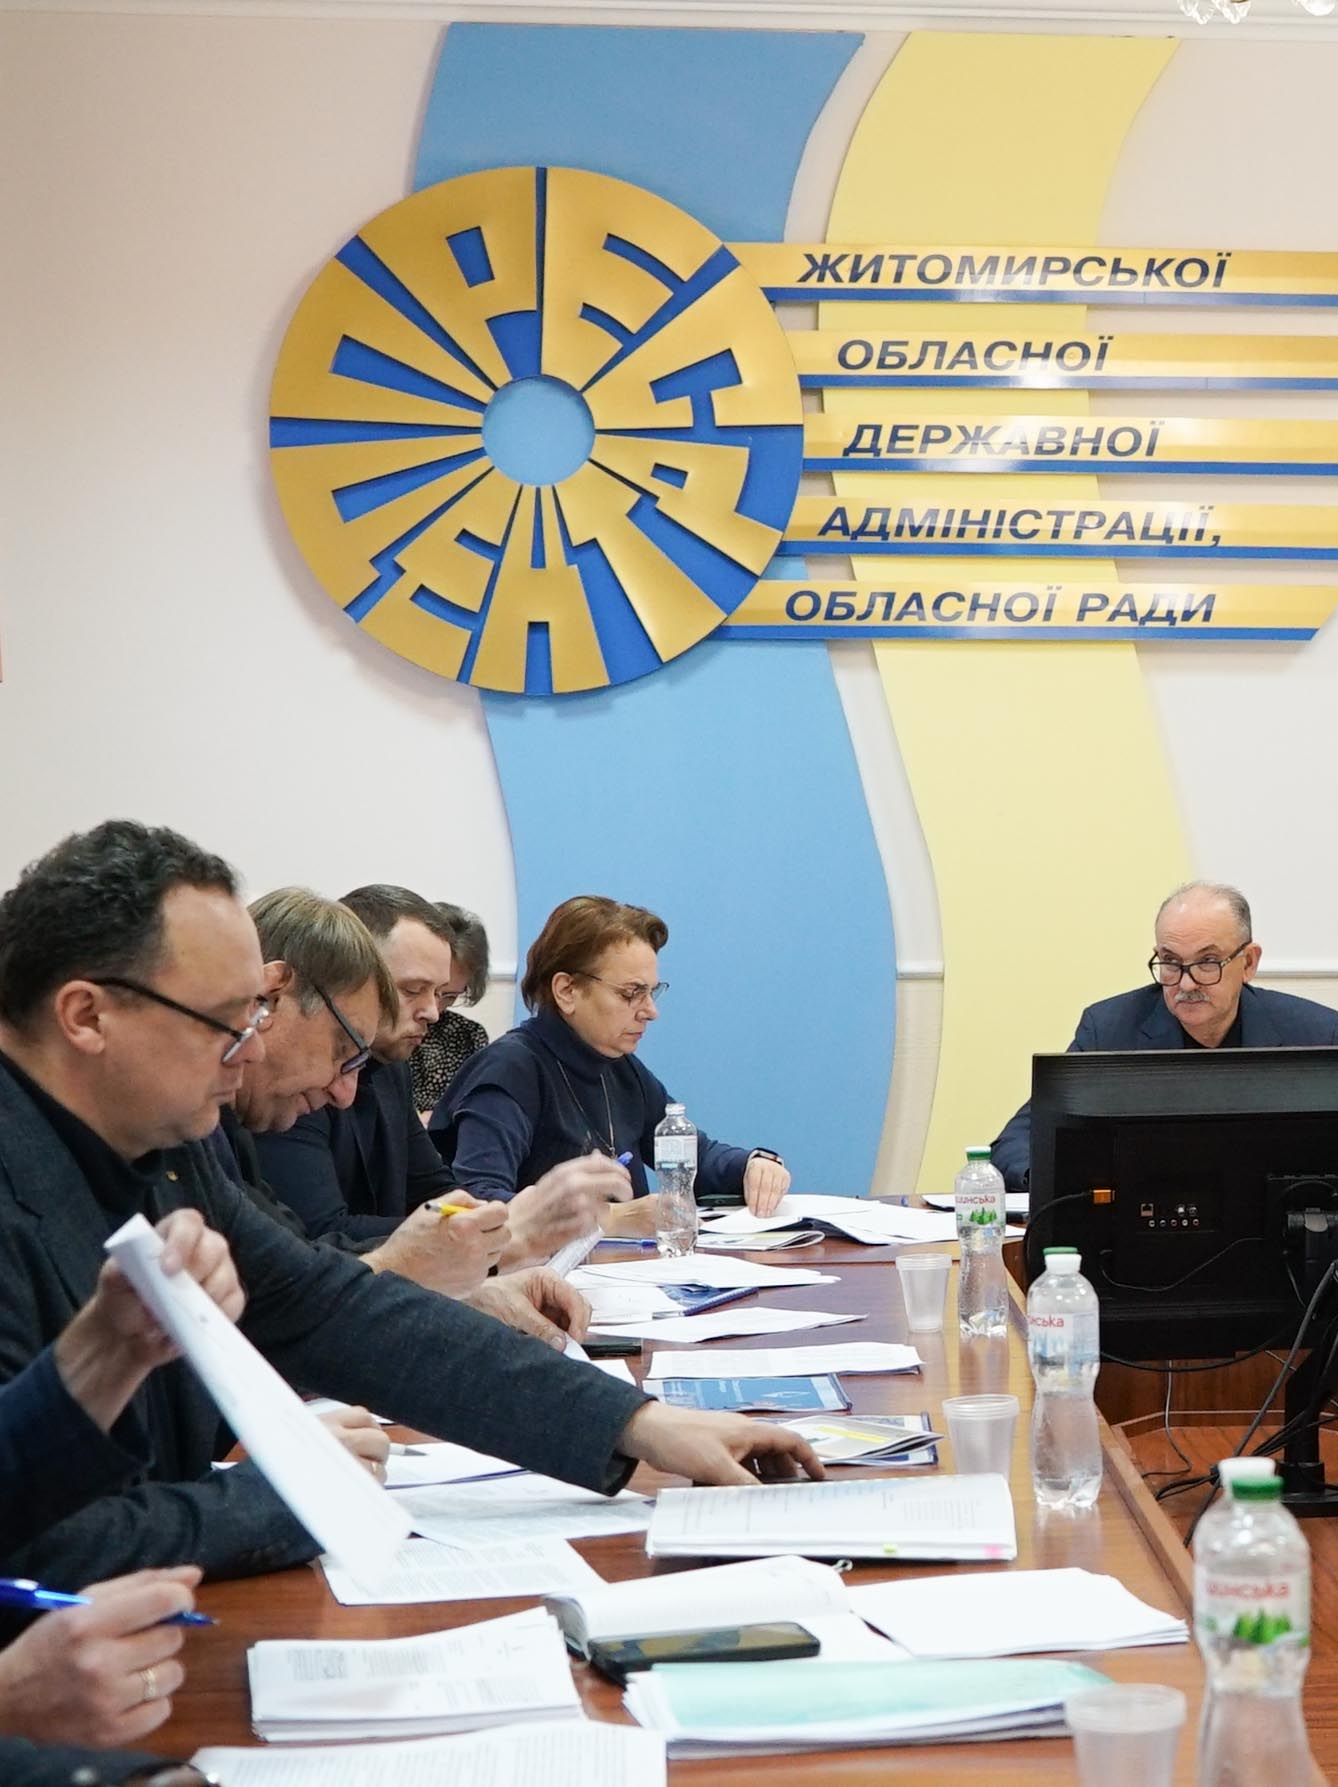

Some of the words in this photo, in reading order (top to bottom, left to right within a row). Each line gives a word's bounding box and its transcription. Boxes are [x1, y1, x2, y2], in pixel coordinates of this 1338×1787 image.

[797, 251, 1233, 288] ЖИТОМИРСЬКОЇ
[837, 335, 1114, 371] ОБЛАСНОЇ
[842, 420, 1165, 458] ДЕРЖАВНОЇ
[818, 504, 1221, 548] АДМІНІСТРАЦІЇ,
[785, 584, 1063, 622] ОБЛАСНОЇ
[1076, 592, 1218, 626] РАДИ
